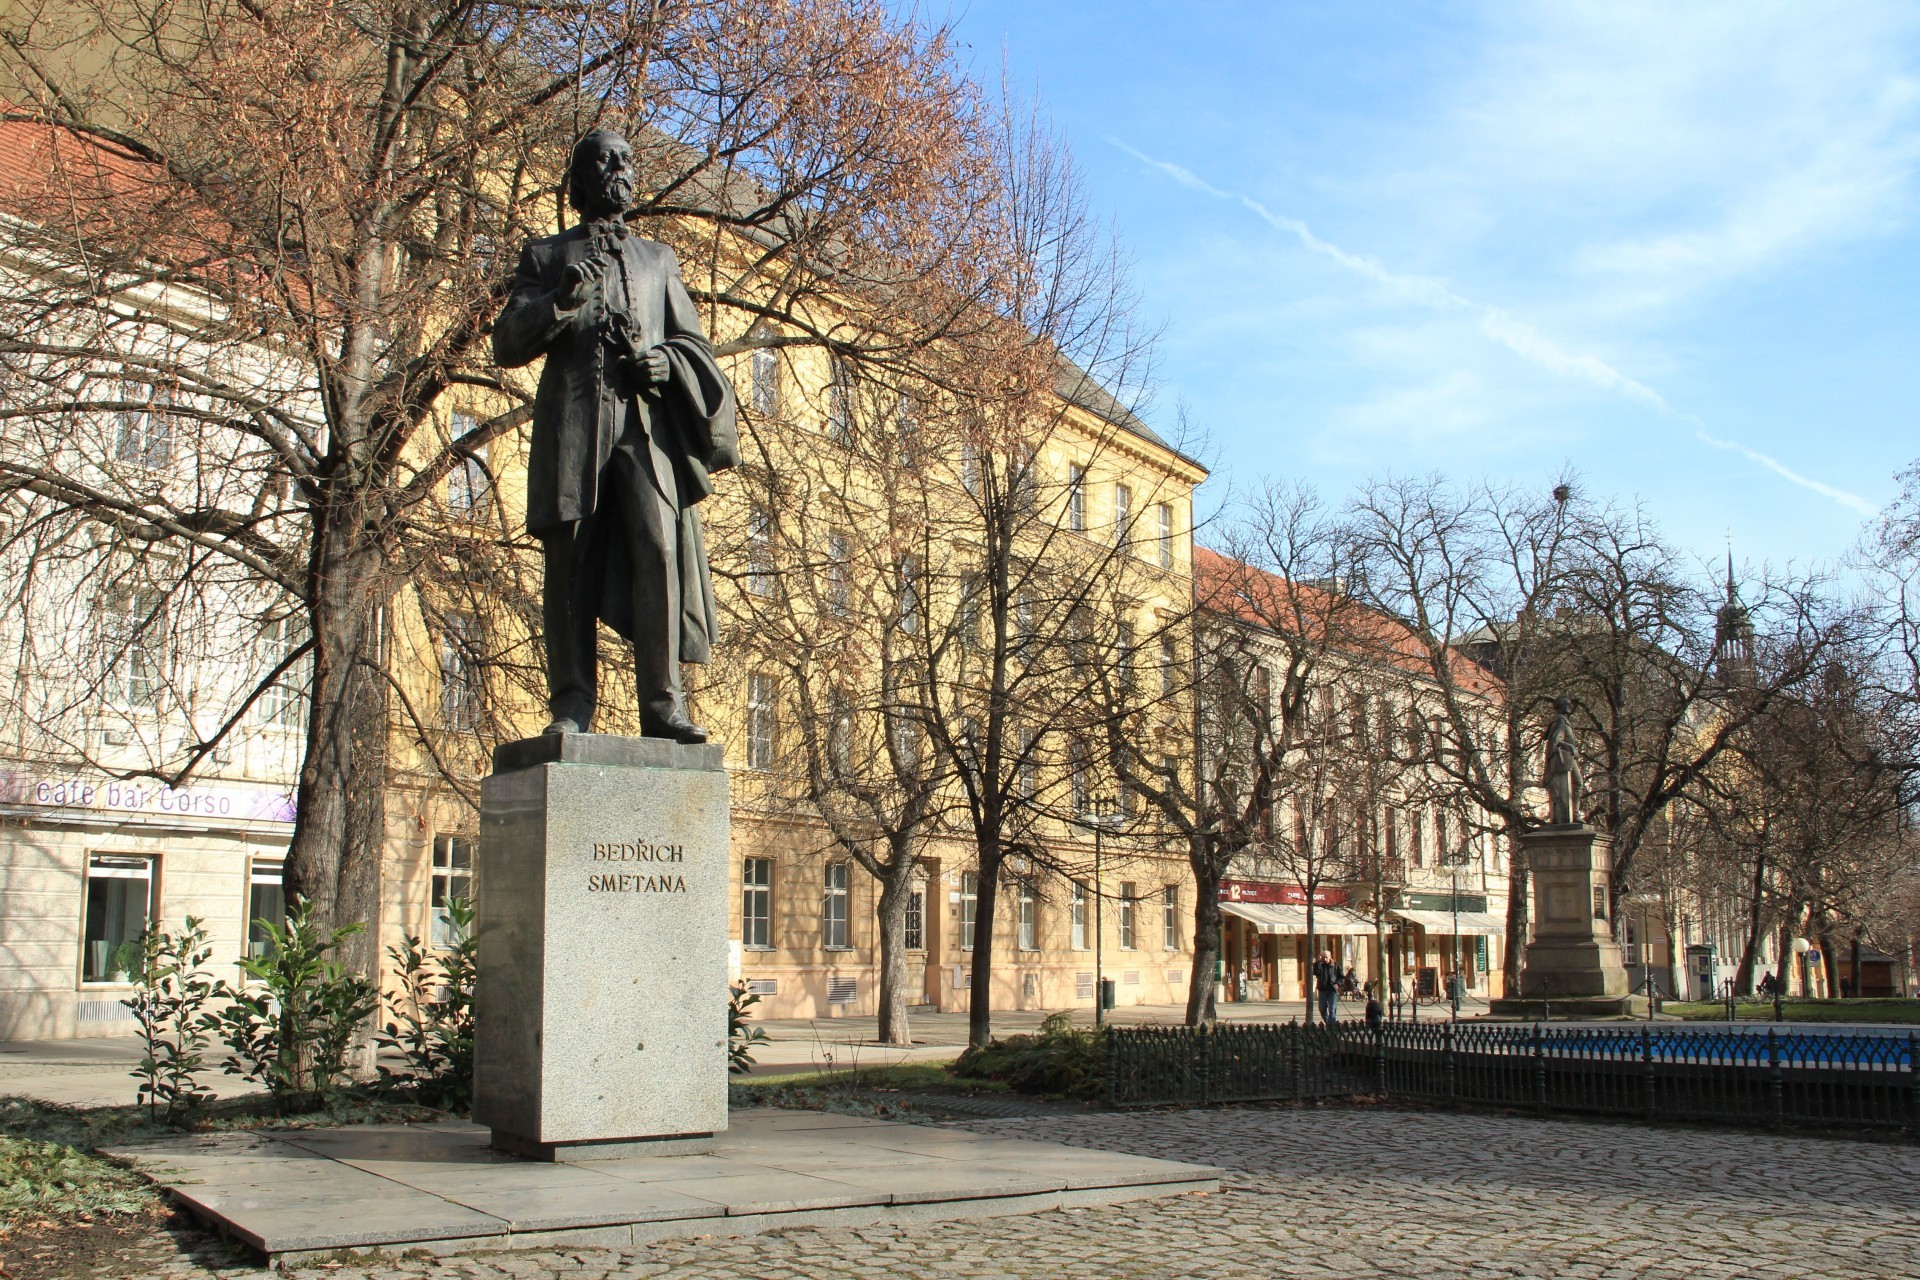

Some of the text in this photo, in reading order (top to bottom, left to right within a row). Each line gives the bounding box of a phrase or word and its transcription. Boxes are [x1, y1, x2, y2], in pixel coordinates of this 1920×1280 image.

[37, 781, 231, 815] cafe bar Corso
[593, 837, 684, 863] BEDŘICH
[588, 874, 687, 893] SMETANA
[1230, 884, 1241, 899] 12
